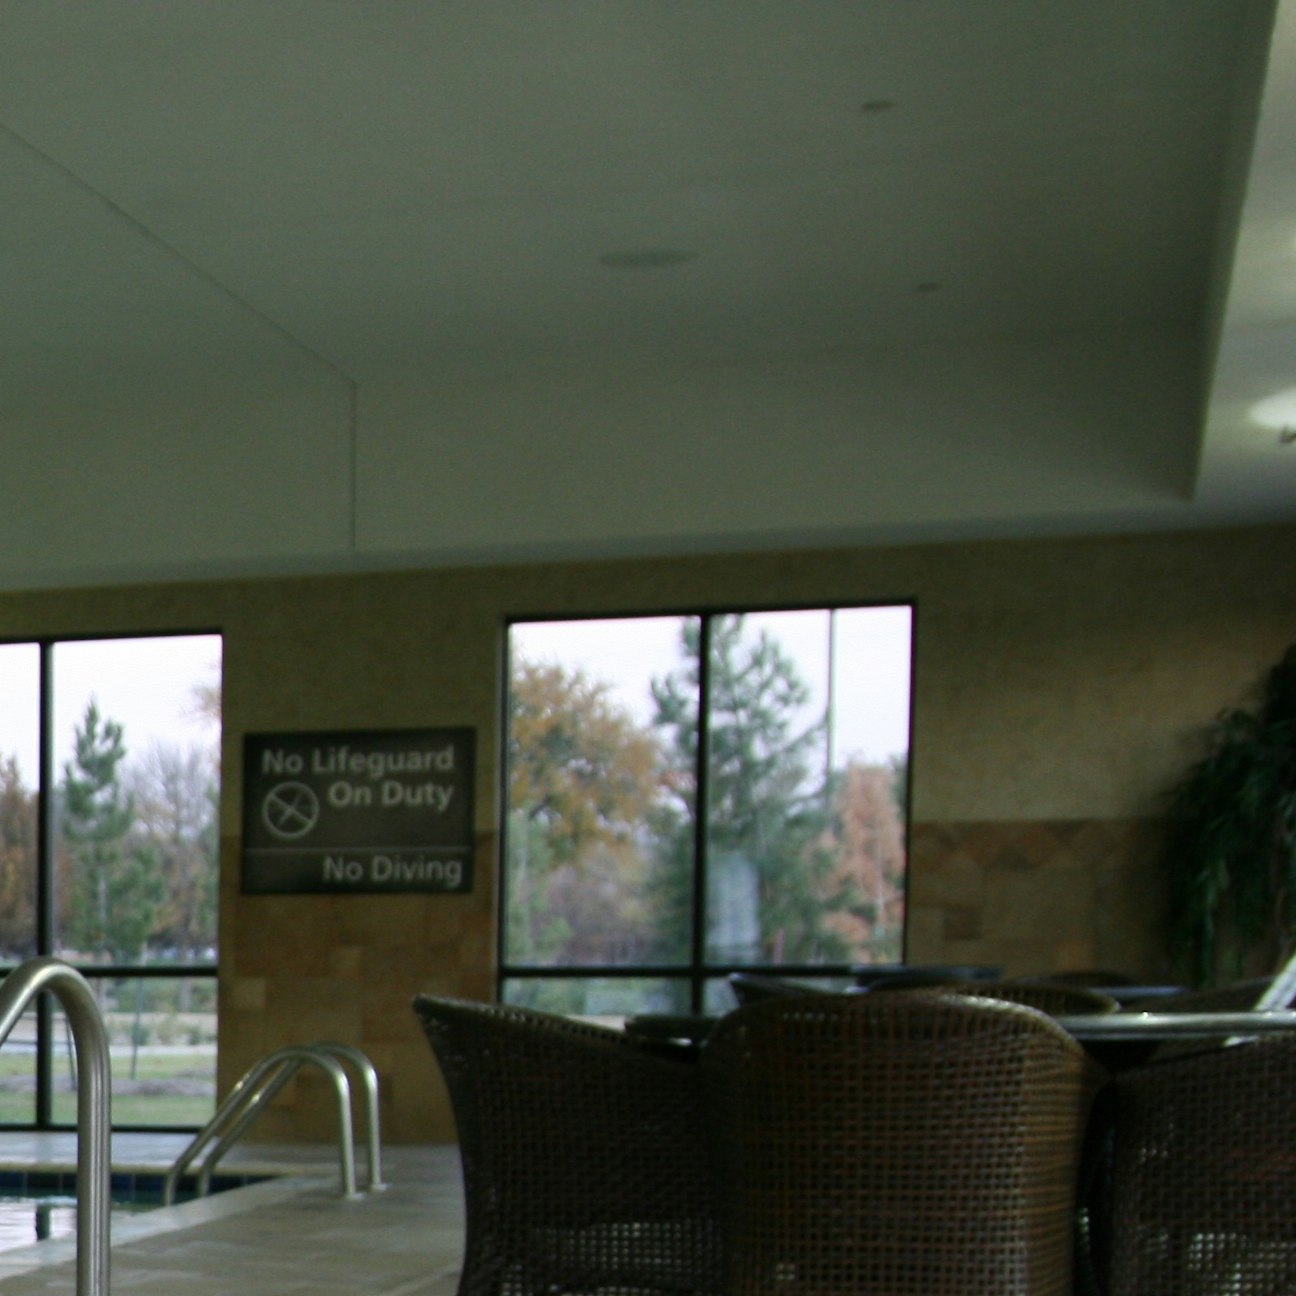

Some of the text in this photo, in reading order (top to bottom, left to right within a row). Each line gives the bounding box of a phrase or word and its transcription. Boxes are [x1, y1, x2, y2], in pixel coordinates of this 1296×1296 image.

[260, 744, 456, 778] No Lifeguard
[328, 780, 456, 814] On Duty
[322, 854, 463, 888] No Diving
